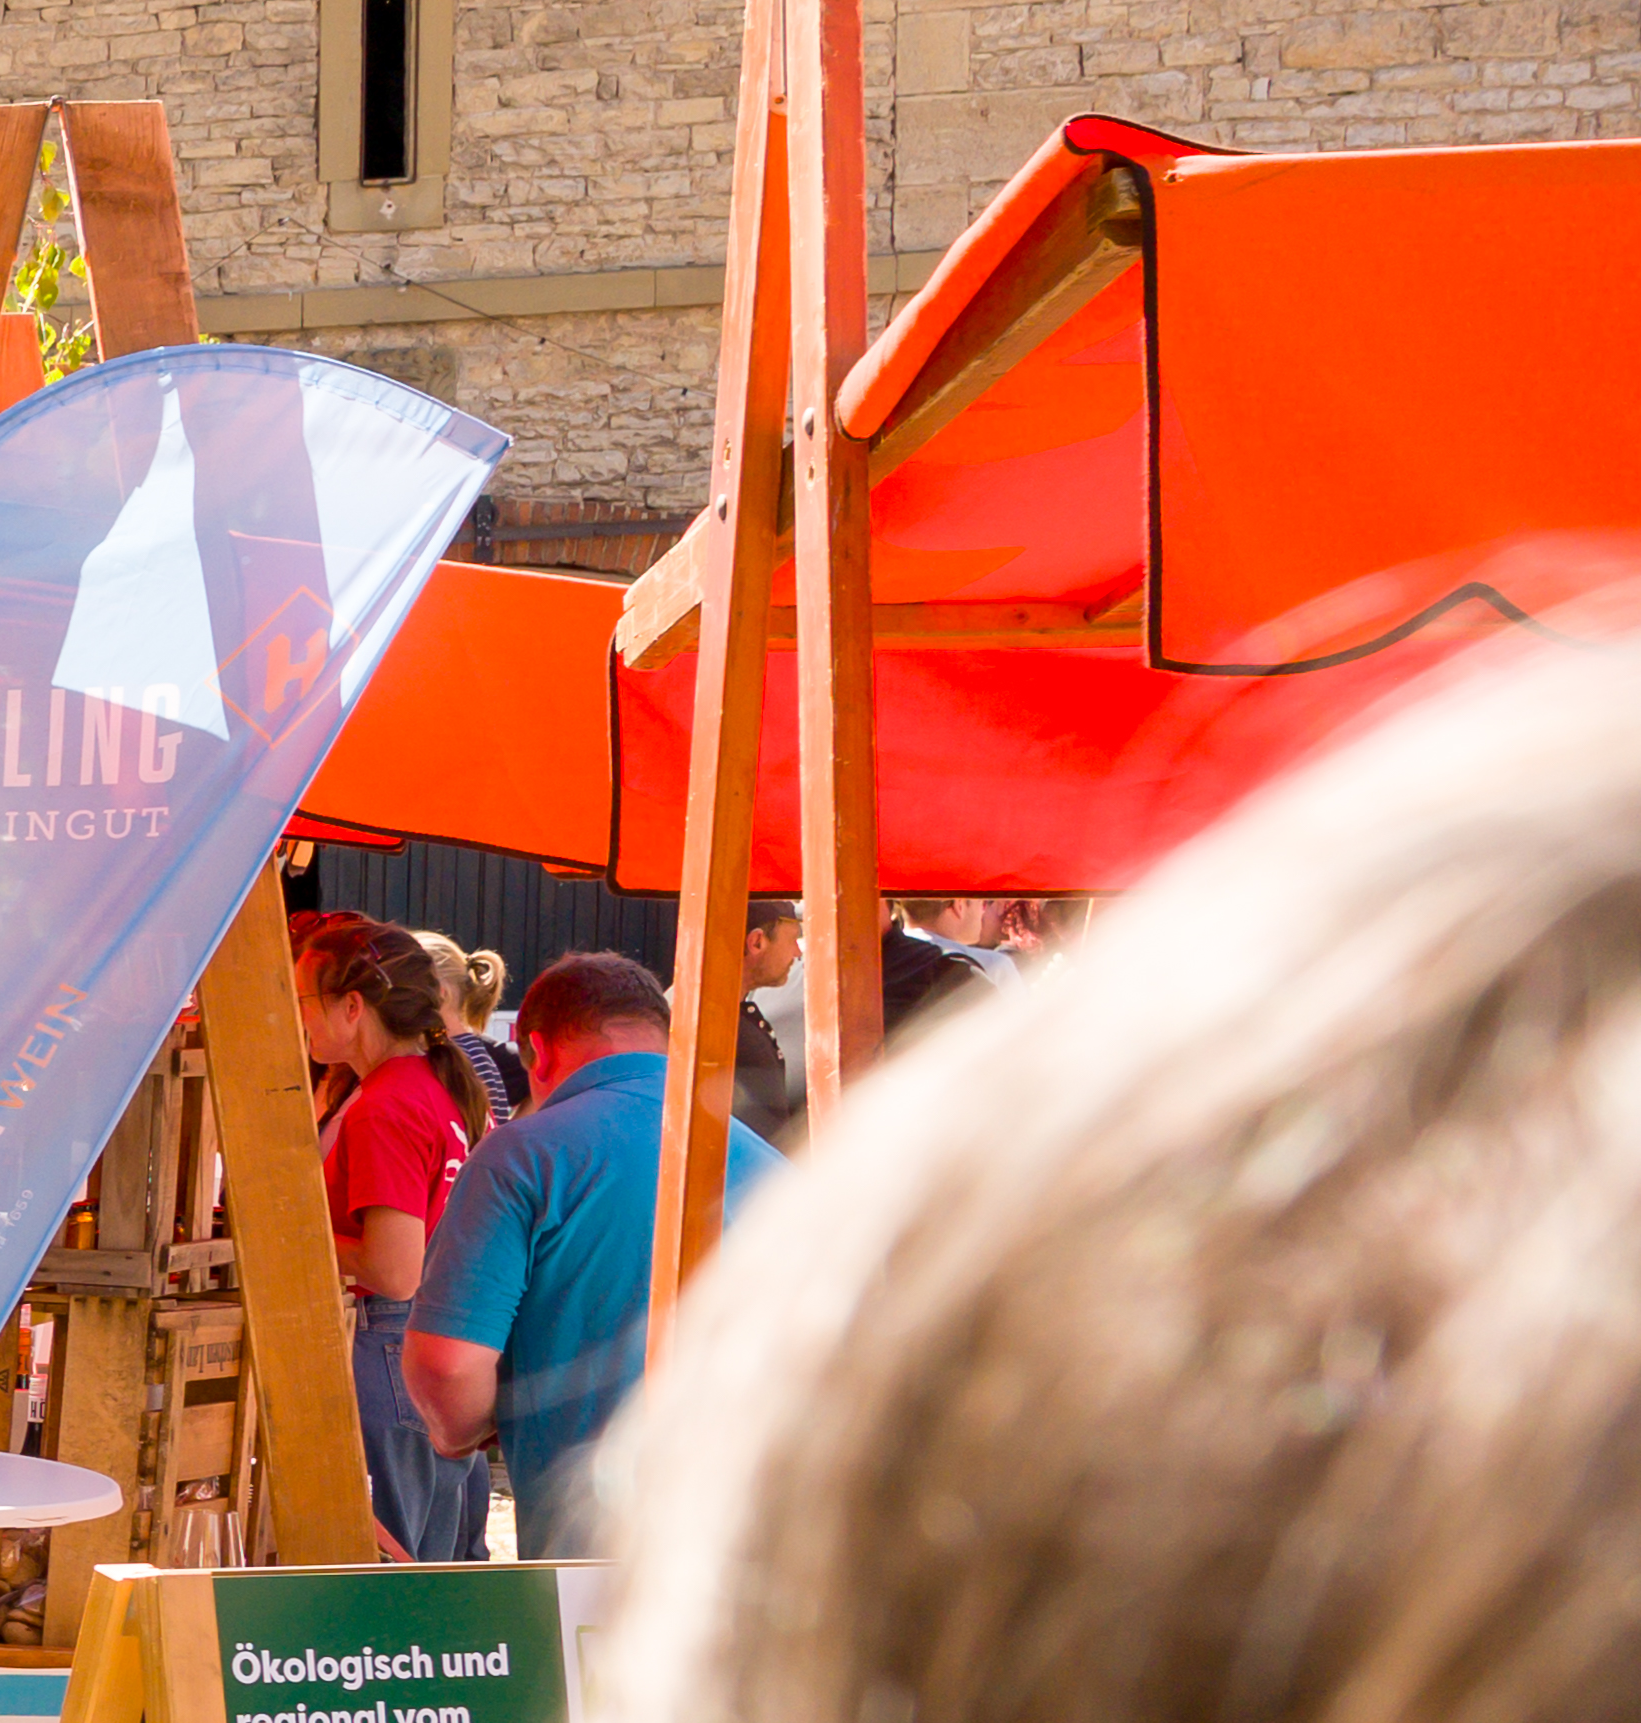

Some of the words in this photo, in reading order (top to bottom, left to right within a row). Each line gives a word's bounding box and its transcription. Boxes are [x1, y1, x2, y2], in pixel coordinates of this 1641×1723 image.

[6, 1188, 36, 1234] 1659
[232, 1643, 434, 1690] Ökologisch
[442, 1643, 510, 1677] und
